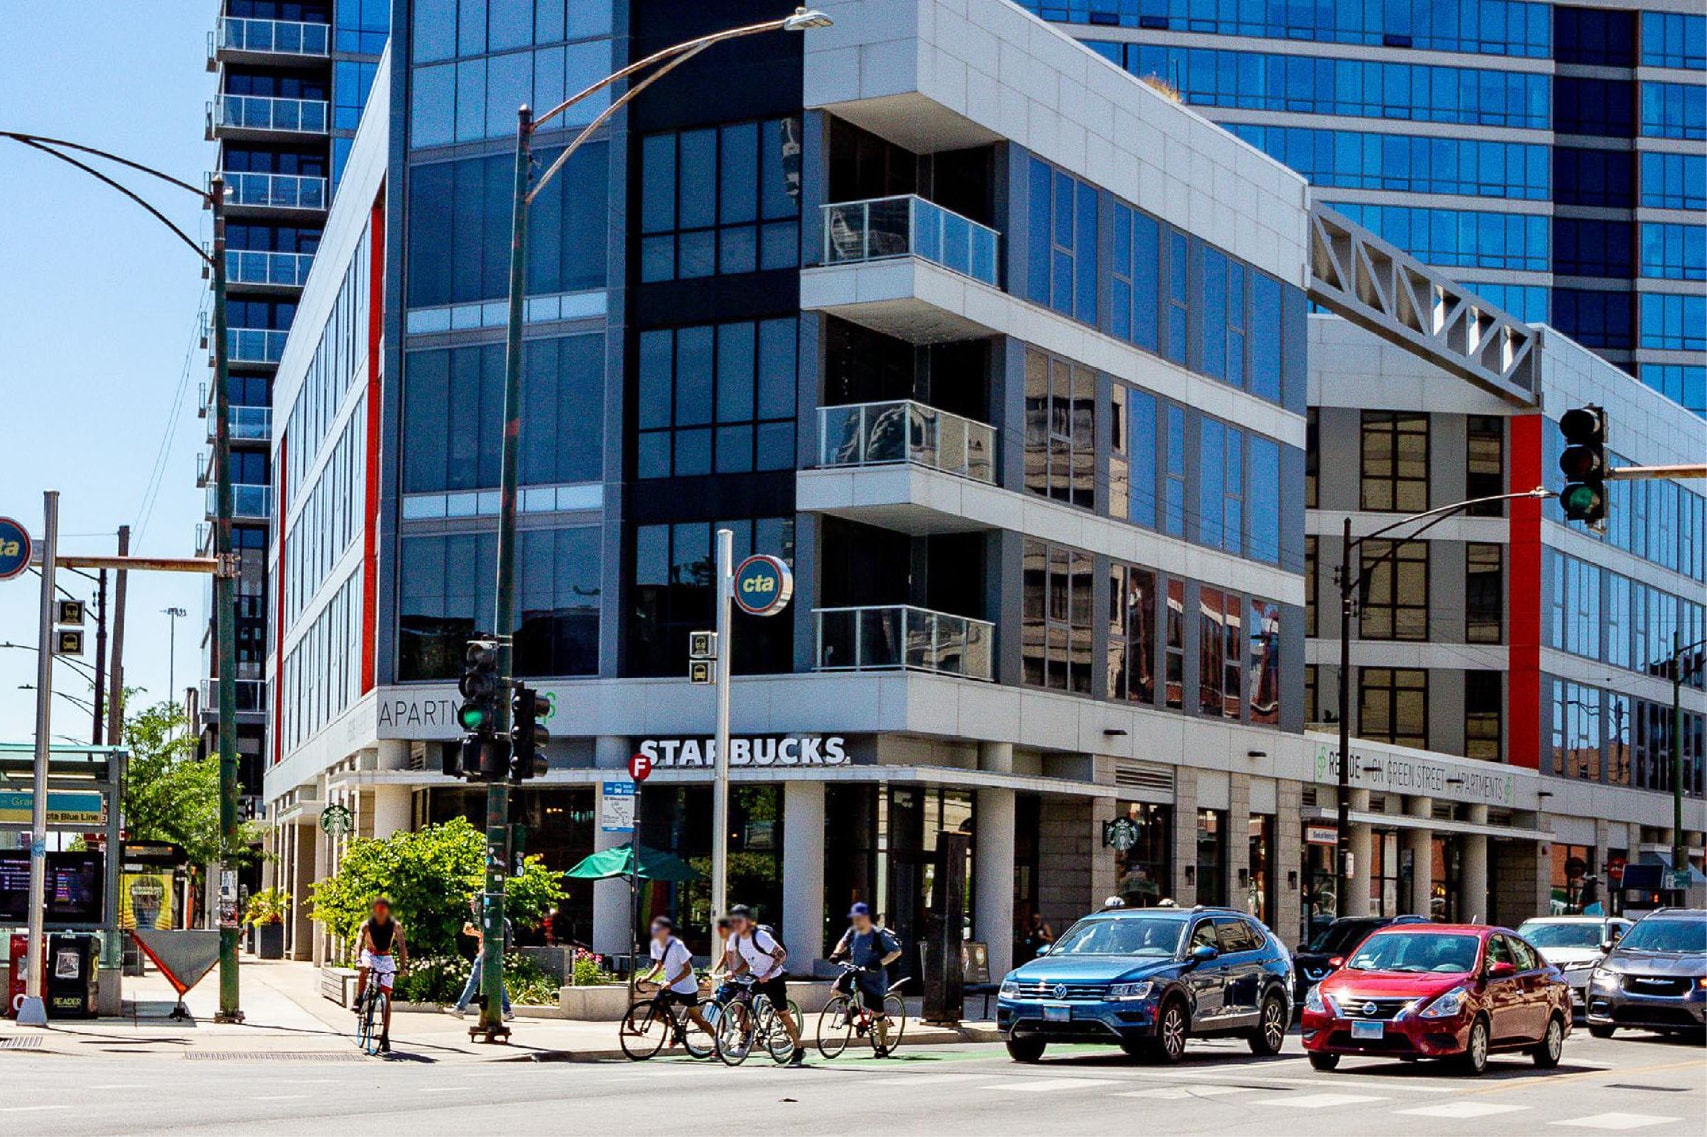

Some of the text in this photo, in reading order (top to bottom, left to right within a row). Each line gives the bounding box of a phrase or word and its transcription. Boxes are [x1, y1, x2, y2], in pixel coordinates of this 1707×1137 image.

[0, 537, 20, 557] ta
[742, 574, 774, 593] cta
[633, 758, 647, 777] F
[1329, 751, 1361, 779] REDE
[1372, 758, 1384, 782] ON
[1387, 760, 1414, 787] GREEN
[1417, 765, 1445, 791] STREET
[60, 812, 79, 821] Blue
[80, 812, 99, 821] Line
